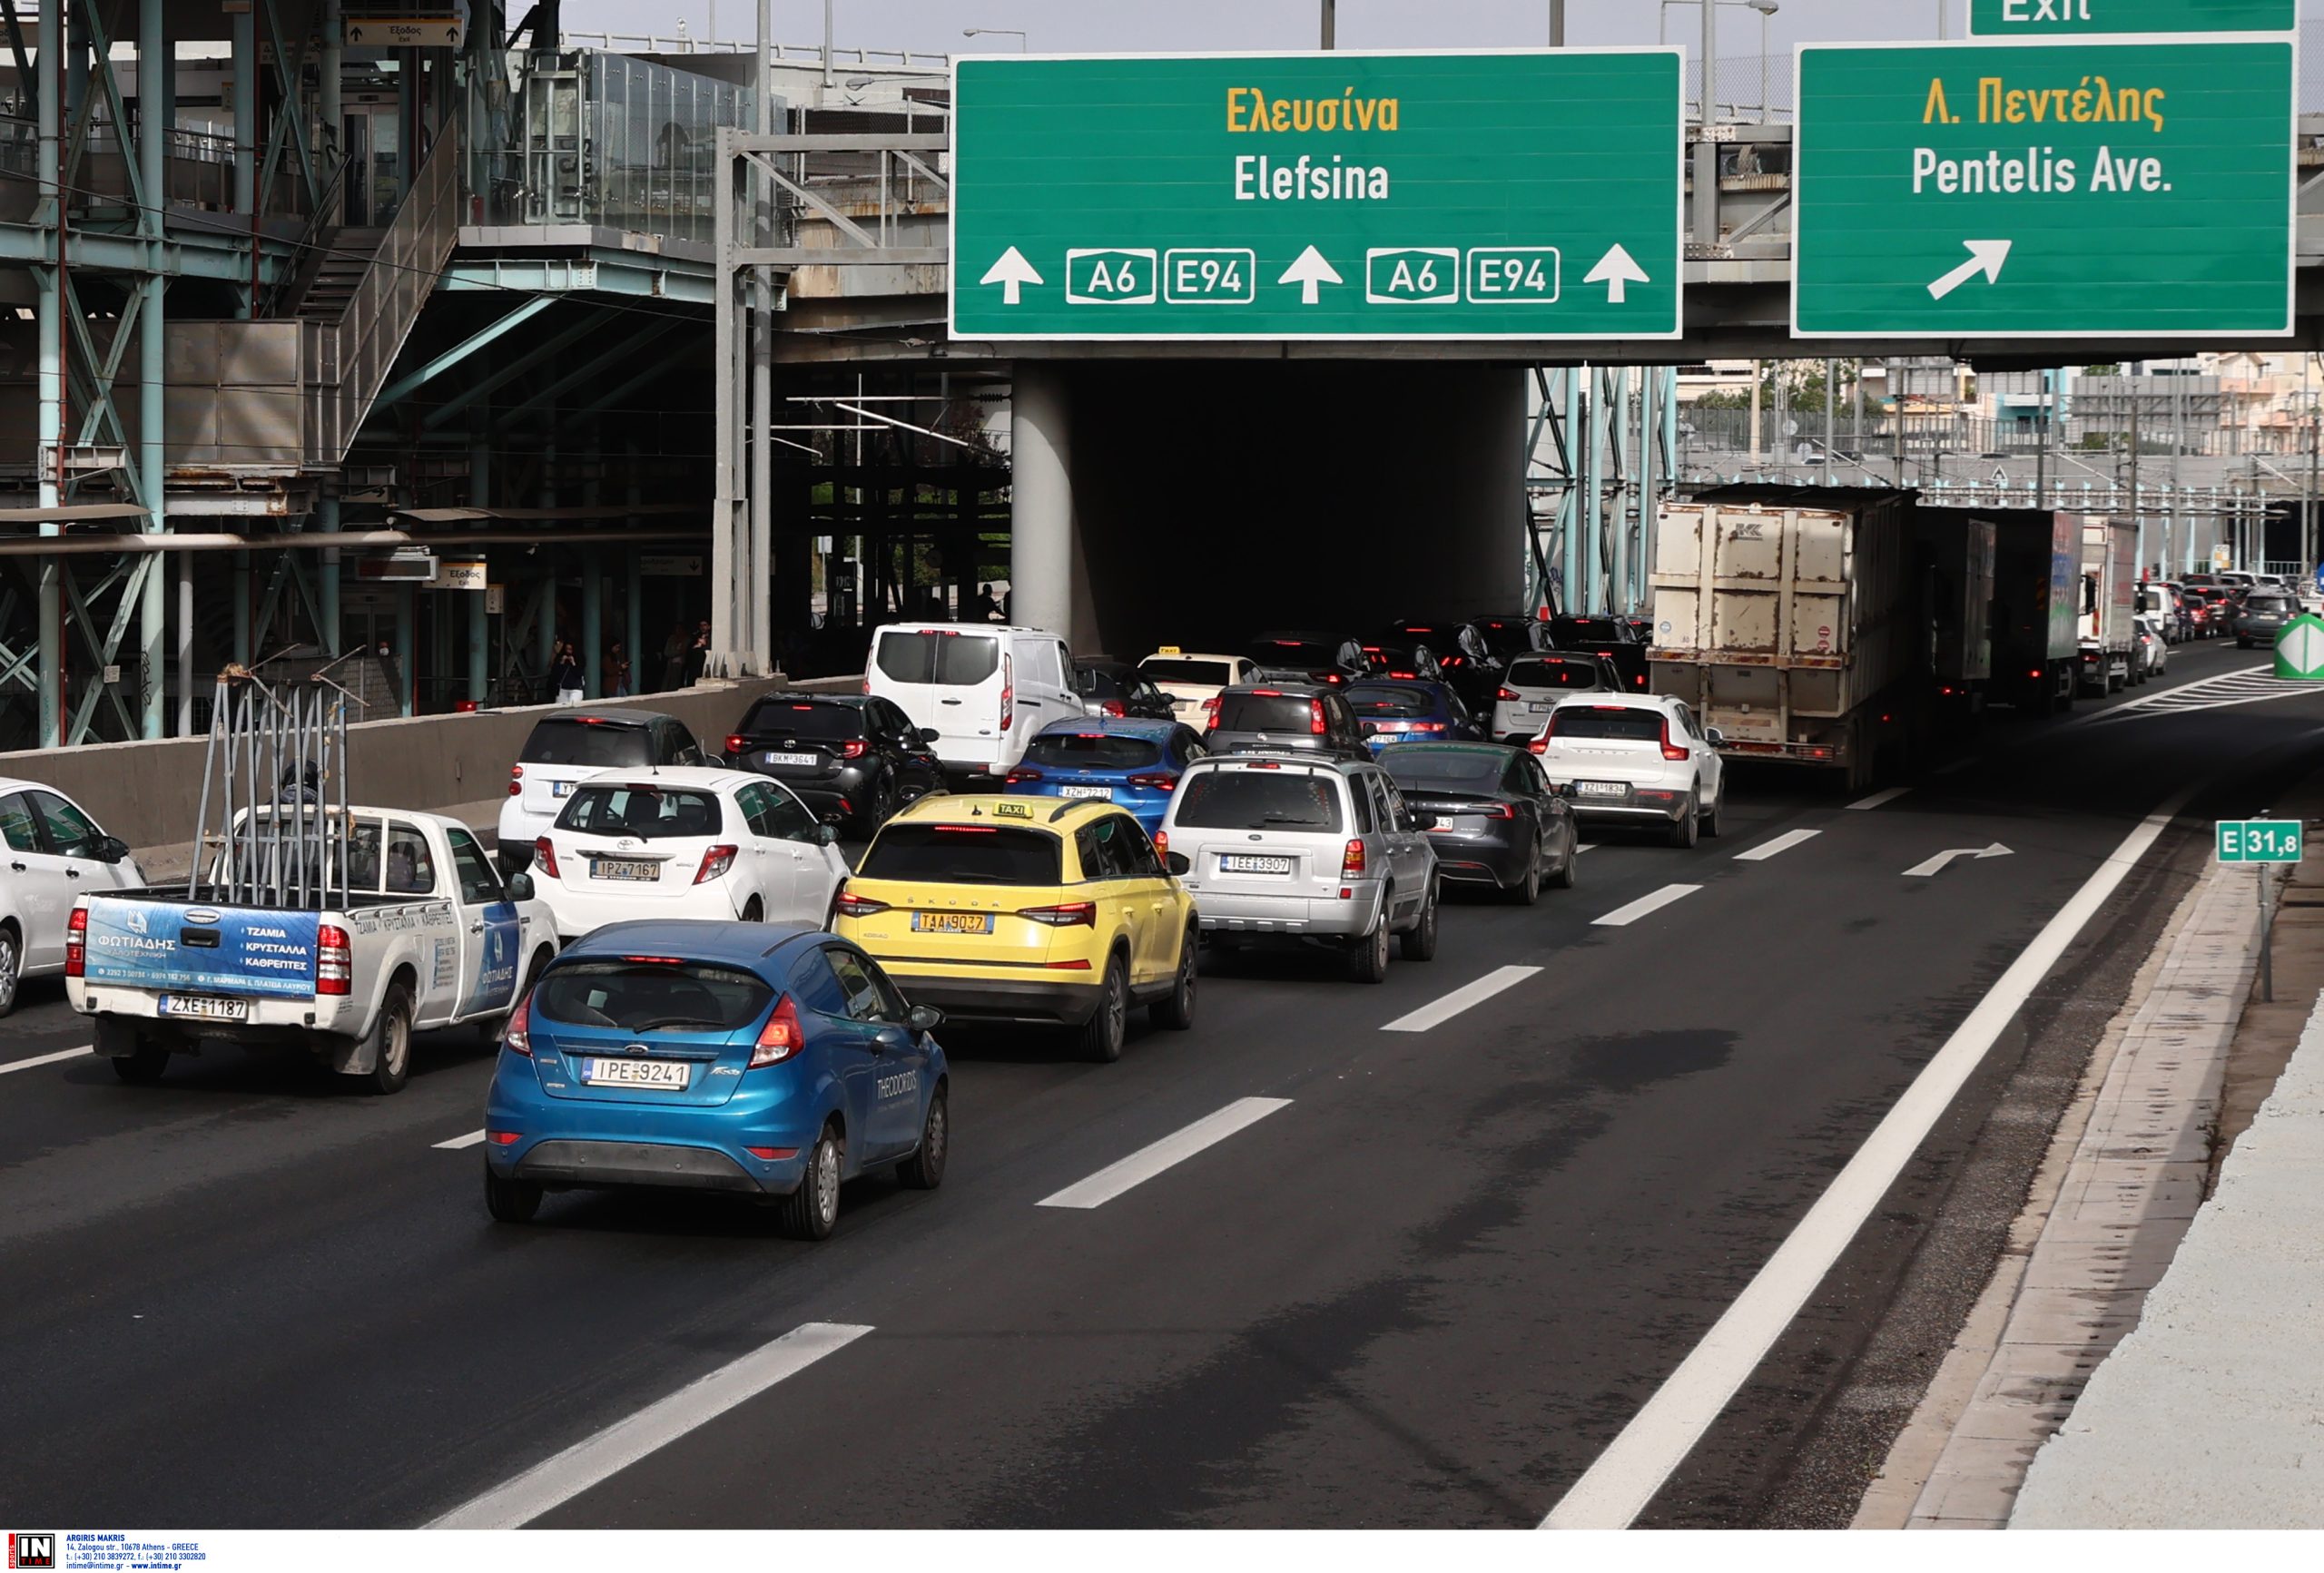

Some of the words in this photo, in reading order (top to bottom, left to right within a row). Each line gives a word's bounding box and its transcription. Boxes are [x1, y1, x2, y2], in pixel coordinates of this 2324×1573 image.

[389, 25, 421, 35] Έξοδος
[1226, 86, 1398, 133] Ελευσίνα
[1922, 78, 1960, 124] Λ.
[1978, 75, 2165, 133] Πεντέλης
[1235, 154, 1389, 201] Elefsina
[1913, 147, 2076, 193] Pentelis
[2090, 145, 2171, 192] Ave.
[1088, 260, 1136, 292] A6
[1177, 260, 1242, 292] E94
[1388, 260, 1437, 292] A6
[1480, 259, 1546, 291] E94
[1000, 804, 1025, 815] TAXI
[2222, 831, 2238, 852] E
[2247, 830, 2297, 857] 31,8
[98, 934, 176, 951] ΦΩΤΙΑΔΗΣ
[246, 927, 286, 939] ΤΖΑΜΙΑ
[246, 942, 307, 956] ΚΡΥΣΤΑΛΛΑ
[245, 958, 308, 971] ΚΑΘΡΕΠΤΕΣ
